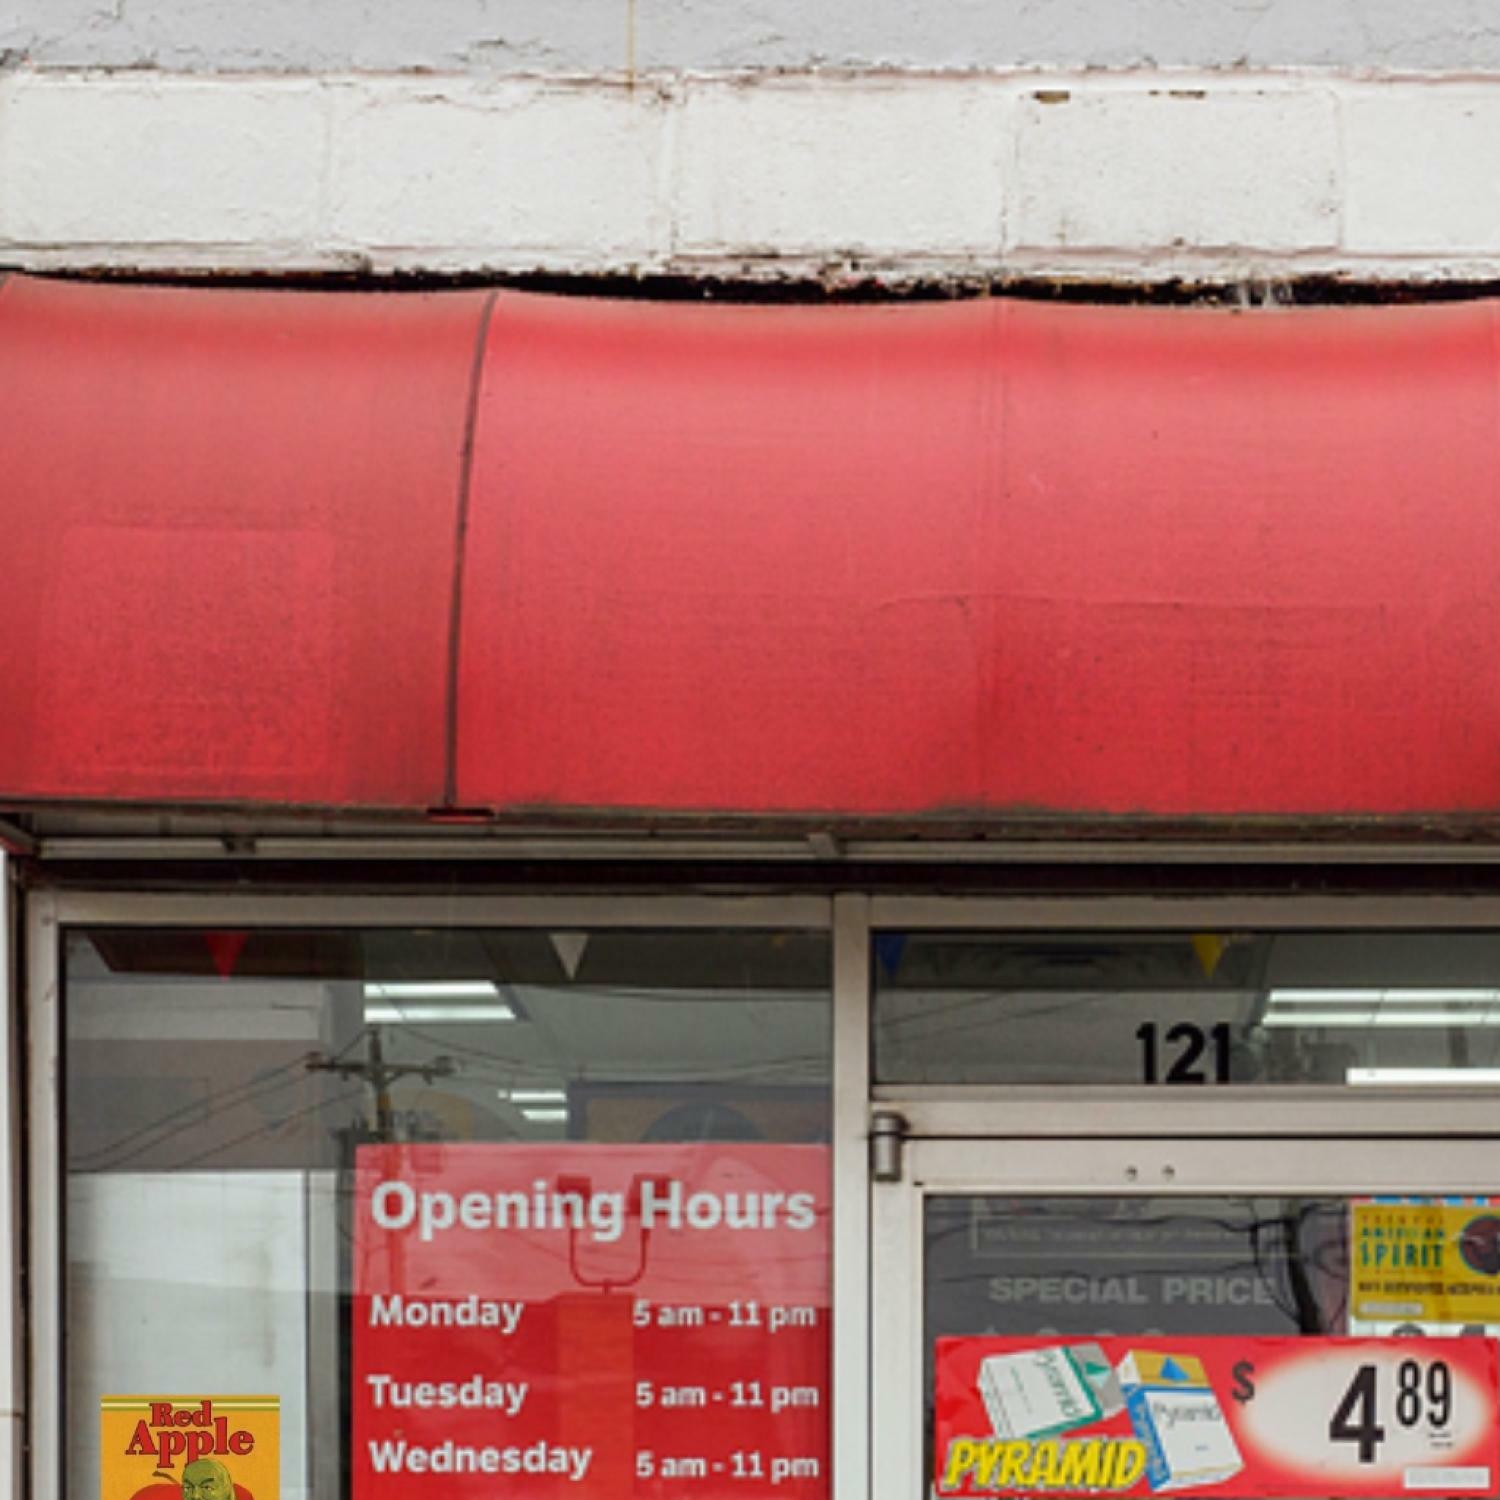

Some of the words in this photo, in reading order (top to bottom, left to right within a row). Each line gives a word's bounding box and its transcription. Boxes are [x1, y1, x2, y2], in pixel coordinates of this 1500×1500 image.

[1136, 1022, 1232, 1085] 121
[371, 1181, 625, 1240] Opening
[641, 1180, 816, 1230] Hours
[1359, 1241, 1444, 1268] SPIRIT
[988, 1275, 1148, 1304] SPECIAL
[1160, 1275, 1276, 1305] PRICE
[370, 1293, 524, 1335] Monday
[368, 1375, 528, 1414] Tuesday
[1231, 1361, 1255, 1402] $
[149, 1400, 213, 1428] Red
[125, 1416, 256, 1469] Apple
[369, 1441, 592, 1480] Wednesday
[941, 1437, 1149, 1491] PYRAMID
